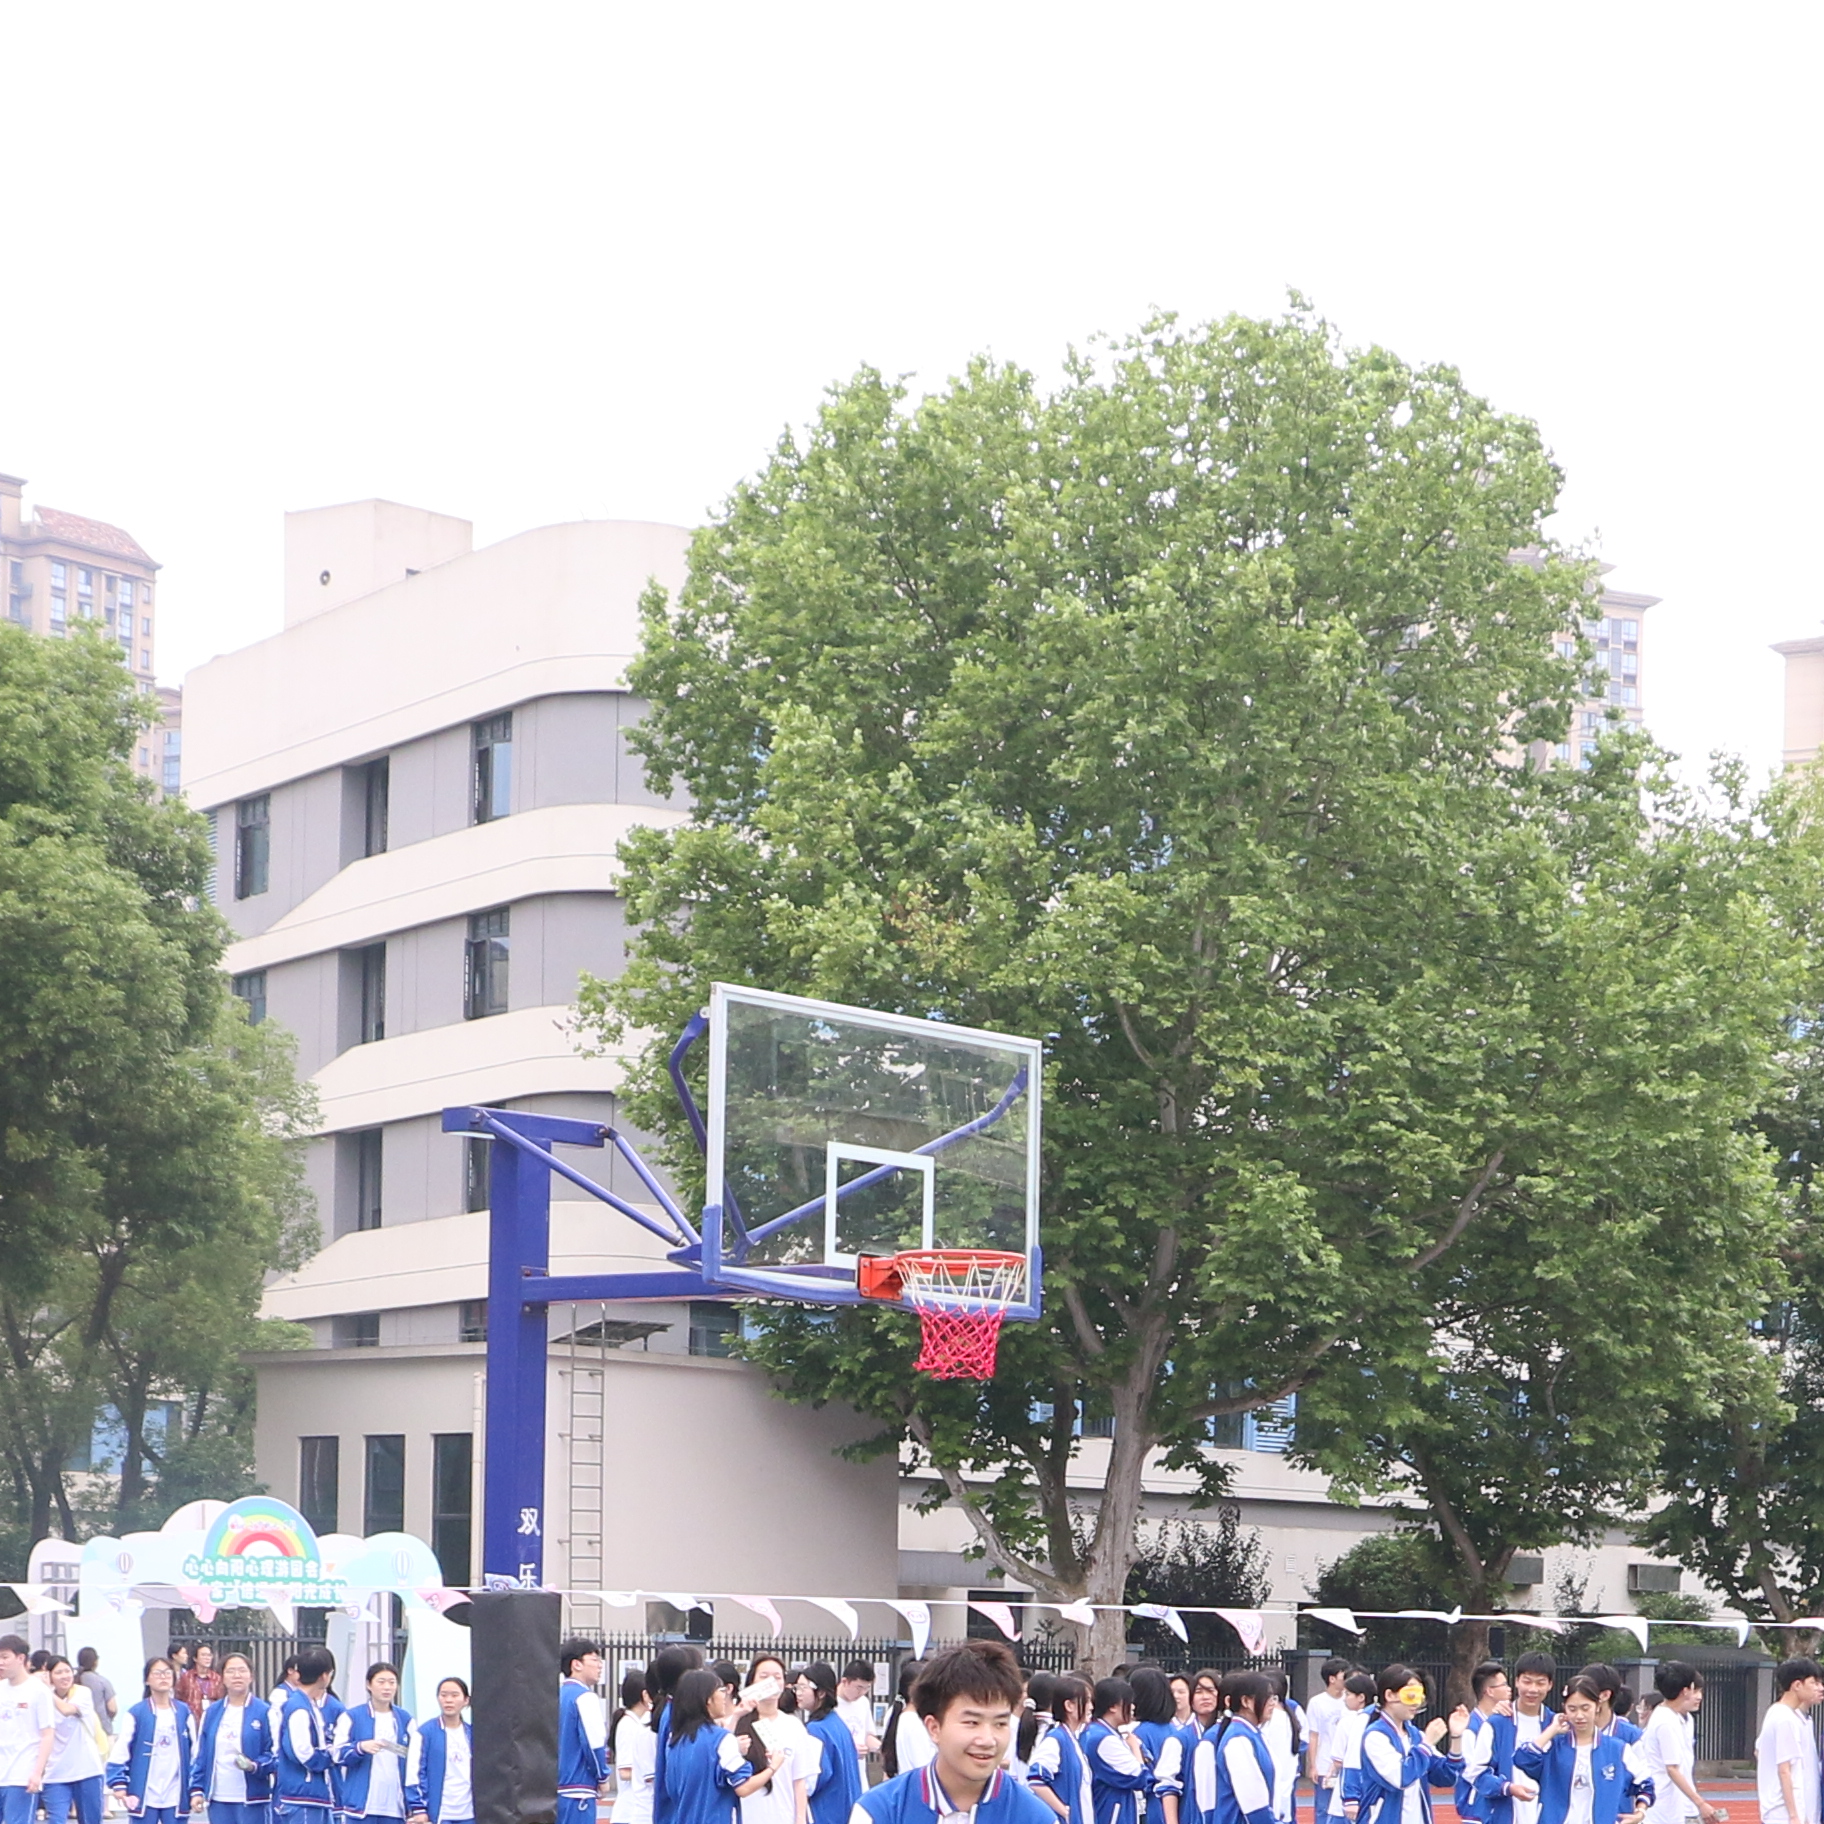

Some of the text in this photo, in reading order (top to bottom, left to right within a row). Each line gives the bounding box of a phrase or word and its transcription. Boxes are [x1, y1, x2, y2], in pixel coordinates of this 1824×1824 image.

[184, 1556, 319, 1578] 心心向阳心理游园会
